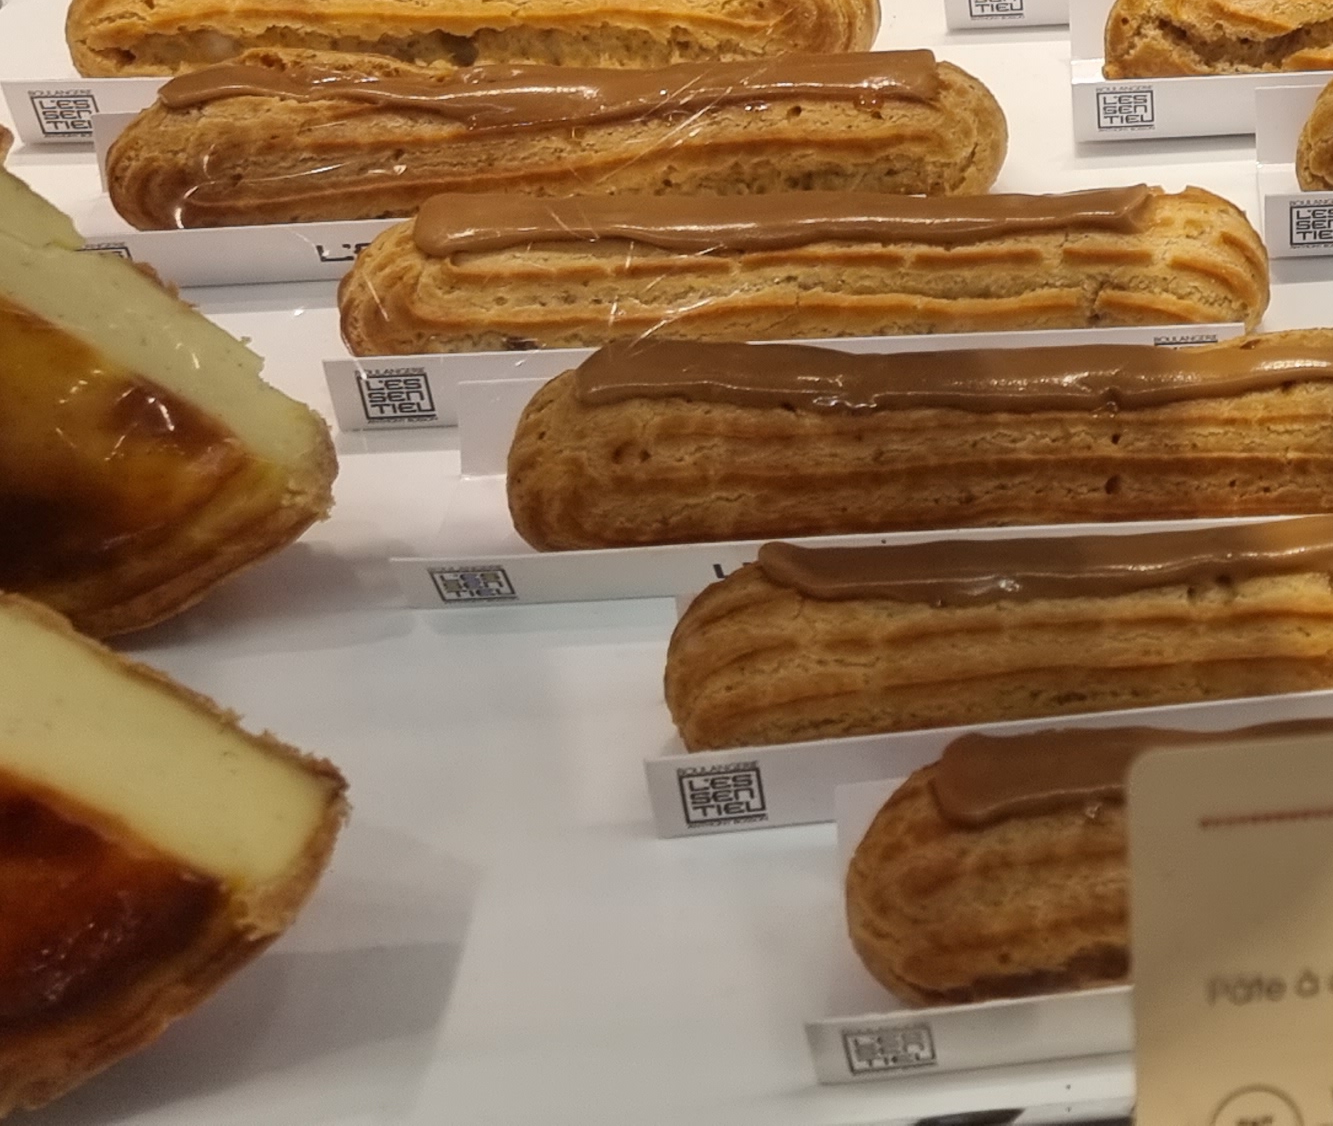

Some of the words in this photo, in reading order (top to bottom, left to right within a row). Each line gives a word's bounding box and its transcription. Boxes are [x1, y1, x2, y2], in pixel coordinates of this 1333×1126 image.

[688, 774, 753, 791] L'ES
[692, 801, 766, 817] TIEL
[1207, 971, 1287, 1007] Pâte
[1295, 965, 1320, 999] à
